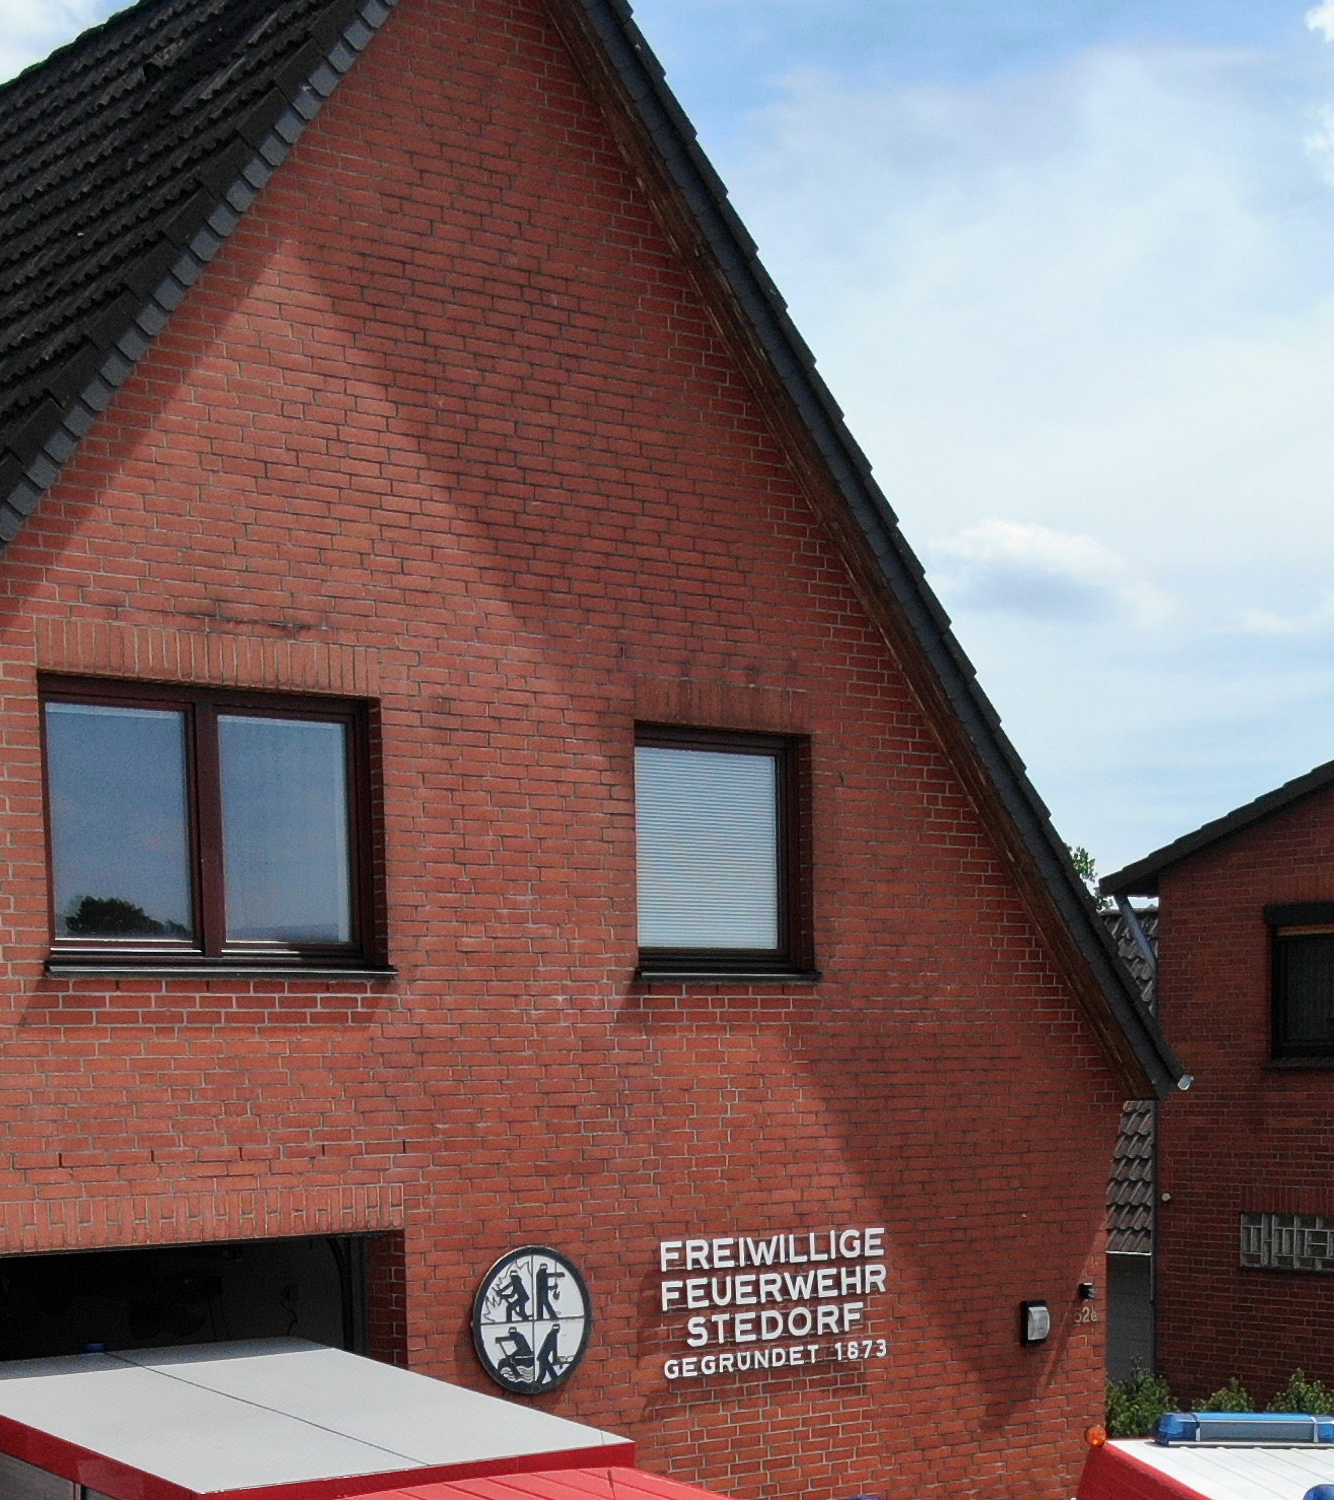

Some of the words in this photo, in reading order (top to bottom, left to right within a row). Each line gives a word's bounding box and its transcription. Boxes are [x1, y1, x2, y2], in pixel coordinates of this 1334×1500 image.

[660, 1227, 885, 1272] FREIWILLIGE
[661, 1264, 887, 1311] FEUERWEHR
[686, 1301, 864, 1347] STEDORF
[664, 1345, 819, 1379] GEGRÜNDET
